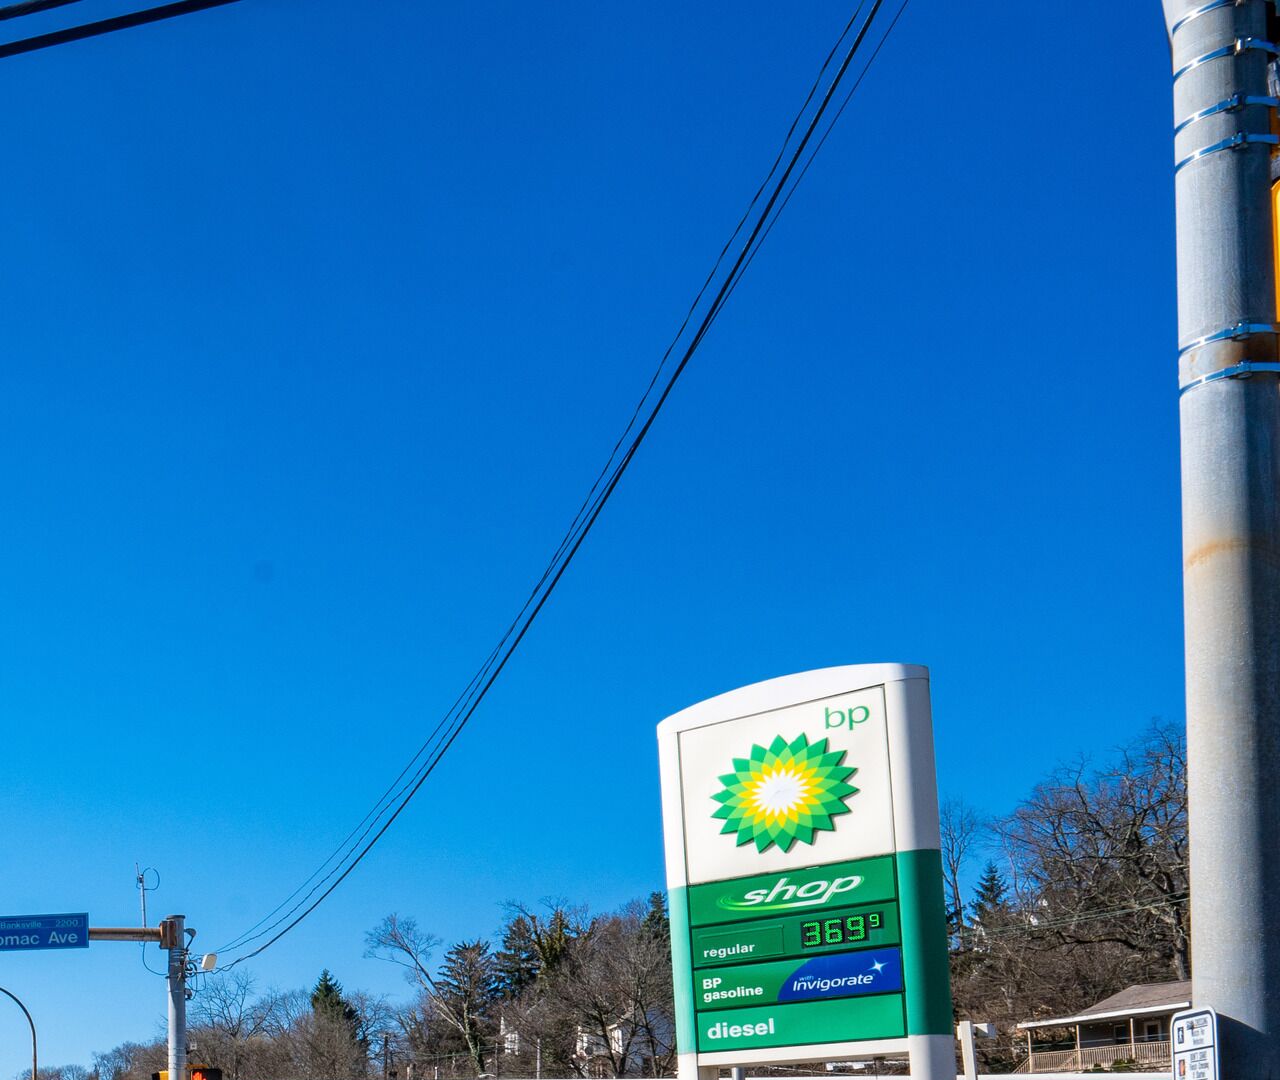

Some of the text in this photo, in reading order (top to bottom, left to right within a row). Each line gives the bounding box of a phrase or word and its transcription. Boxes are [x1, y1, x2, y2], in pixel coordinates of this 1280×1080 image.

[825, 705, 870, 731] bp
[743, 875, 864, 906] shop
[0, 921, 42, 930] Banksville
[48, 931, 79, 944] Ave
[703, 943, 756, 958] regular
[702, 977, 722, 990] BP
[793, 974, 874, 992] Invigorate
[703, 985, 764, 1003] gasoline
[707, 1018, 775, 1039] diesel
